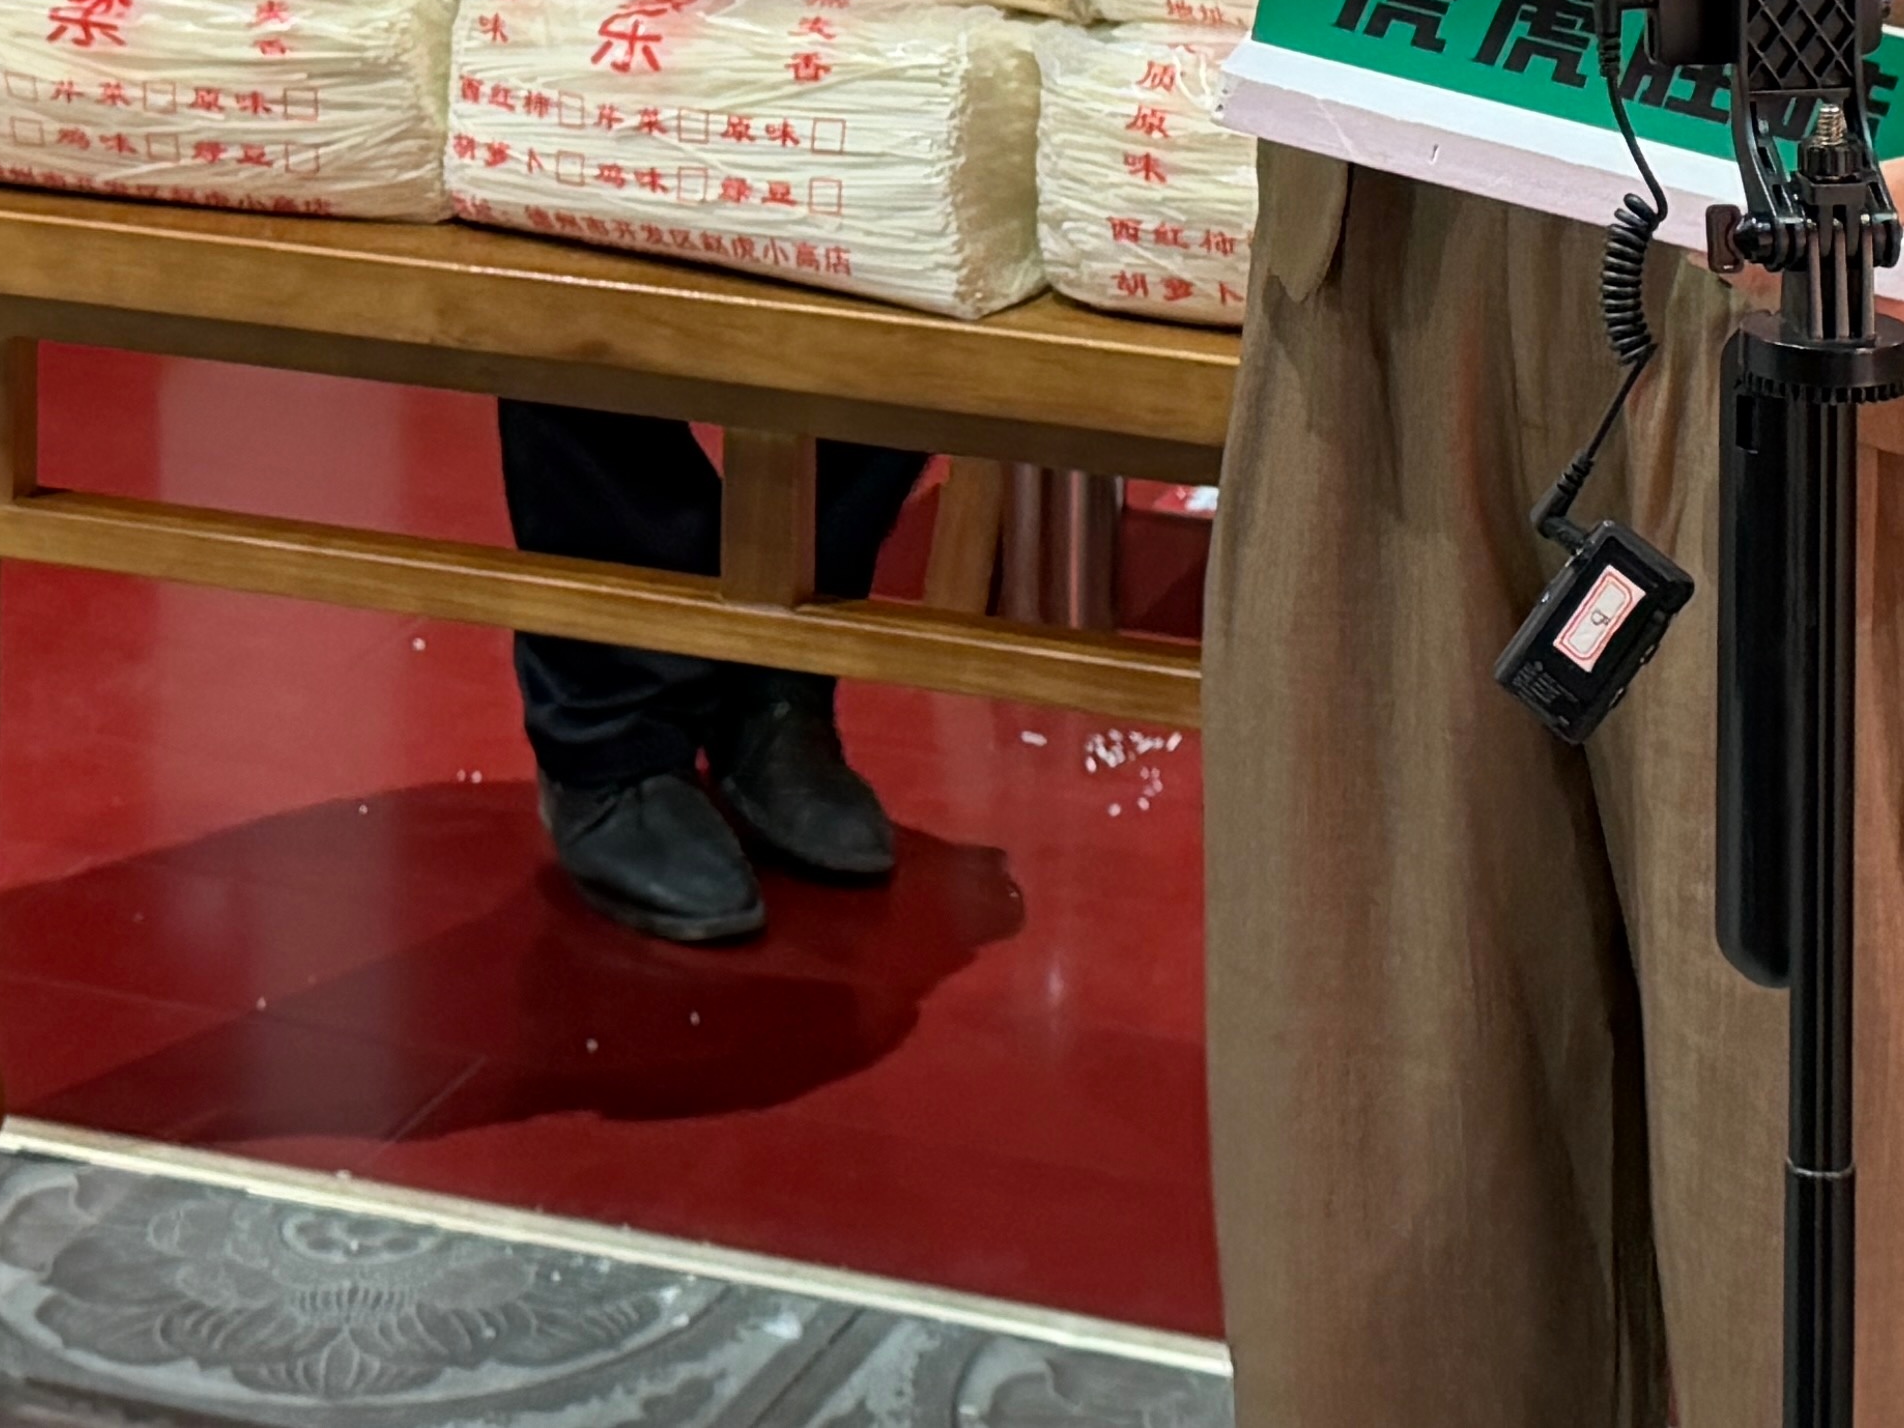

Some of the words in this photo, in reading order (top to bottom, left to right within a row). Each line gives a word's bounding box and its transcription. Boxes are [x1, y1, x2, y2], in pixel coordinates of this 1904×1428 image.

[191, 87, 273, 115] 原味
[459, 74, 552, 119] 西红柿
[594, 101, 669, 137] 芹菜
[719, 114, 801, 146] 原味
[452, 133, 544, 174] 胡萝卜
[1107, 215, 1237, 257] 西红柿
[1112, 270, 1244, 307] 胡萝卜
